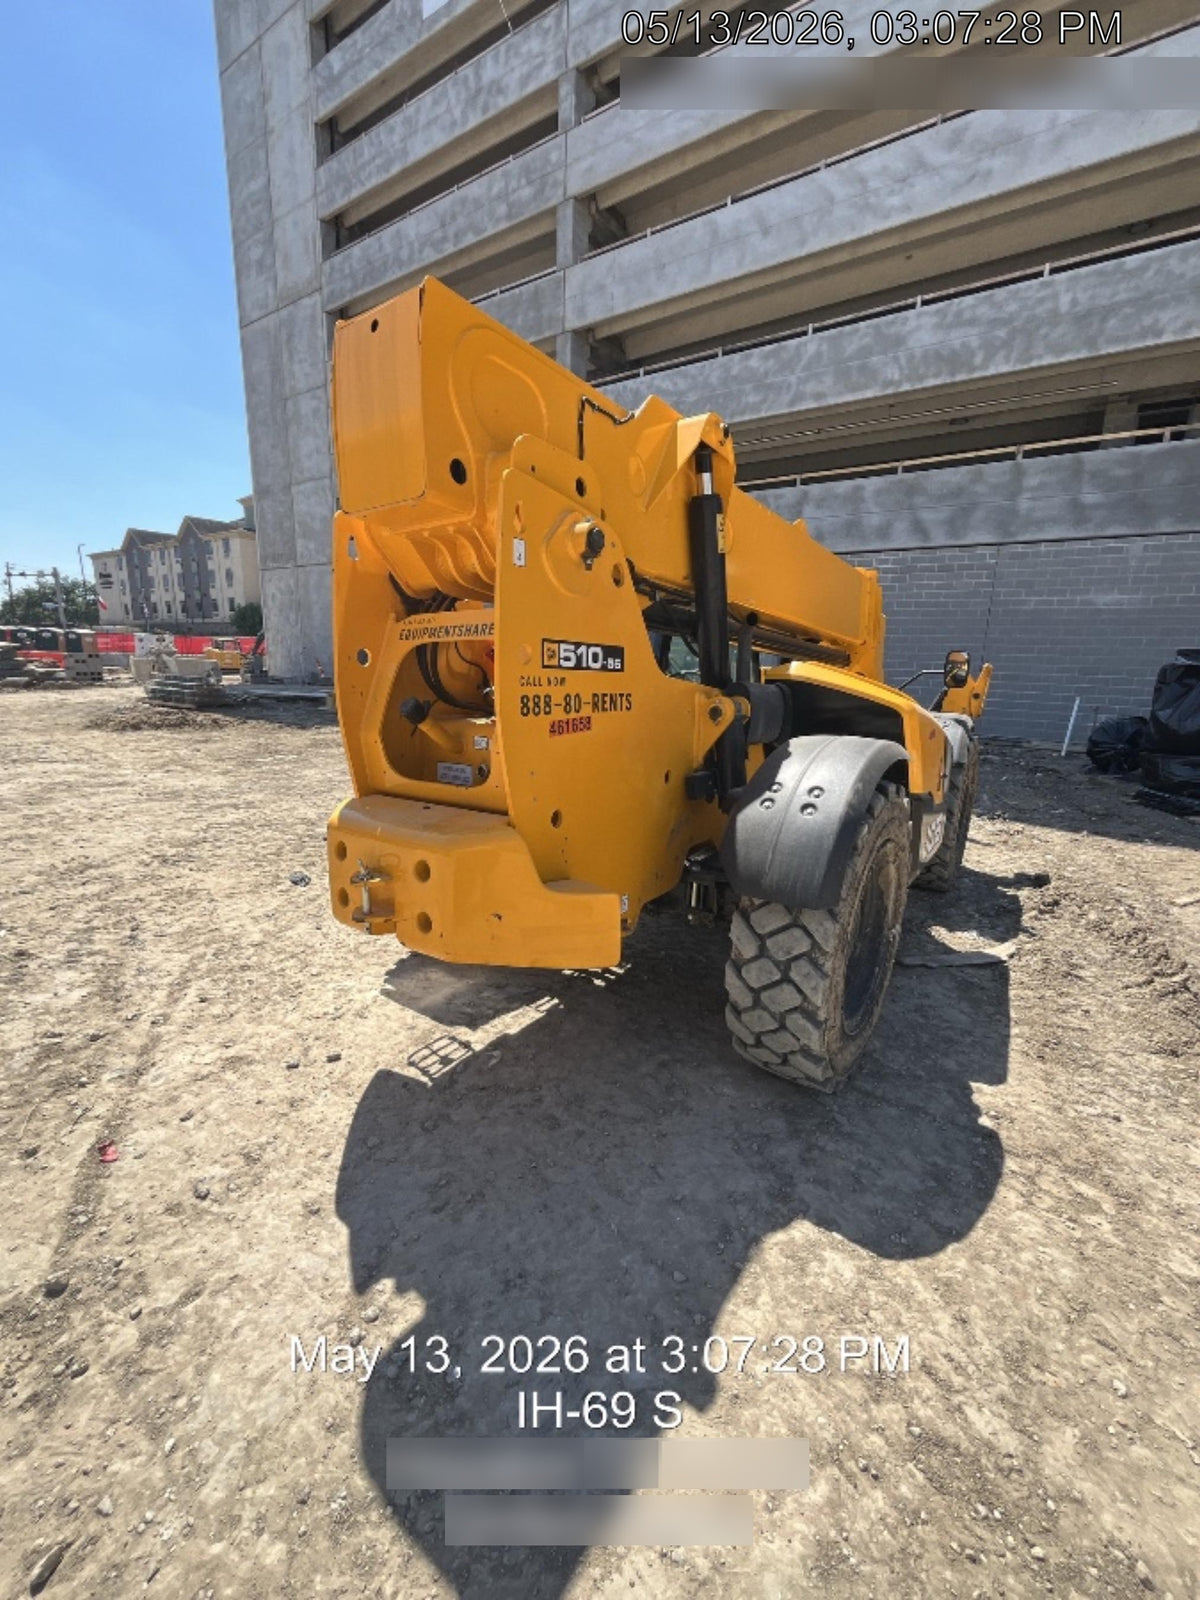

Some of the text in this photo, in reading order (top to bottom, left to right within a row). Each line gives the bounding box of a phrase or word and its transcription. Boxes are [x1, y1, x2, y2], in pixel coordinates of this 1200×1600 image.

[399, 623, 495, 640] EQUIPMENTSHARE
[520, 675, 543, 687] CALL
[520, 693, 632, 717] 888-80-RENTS
